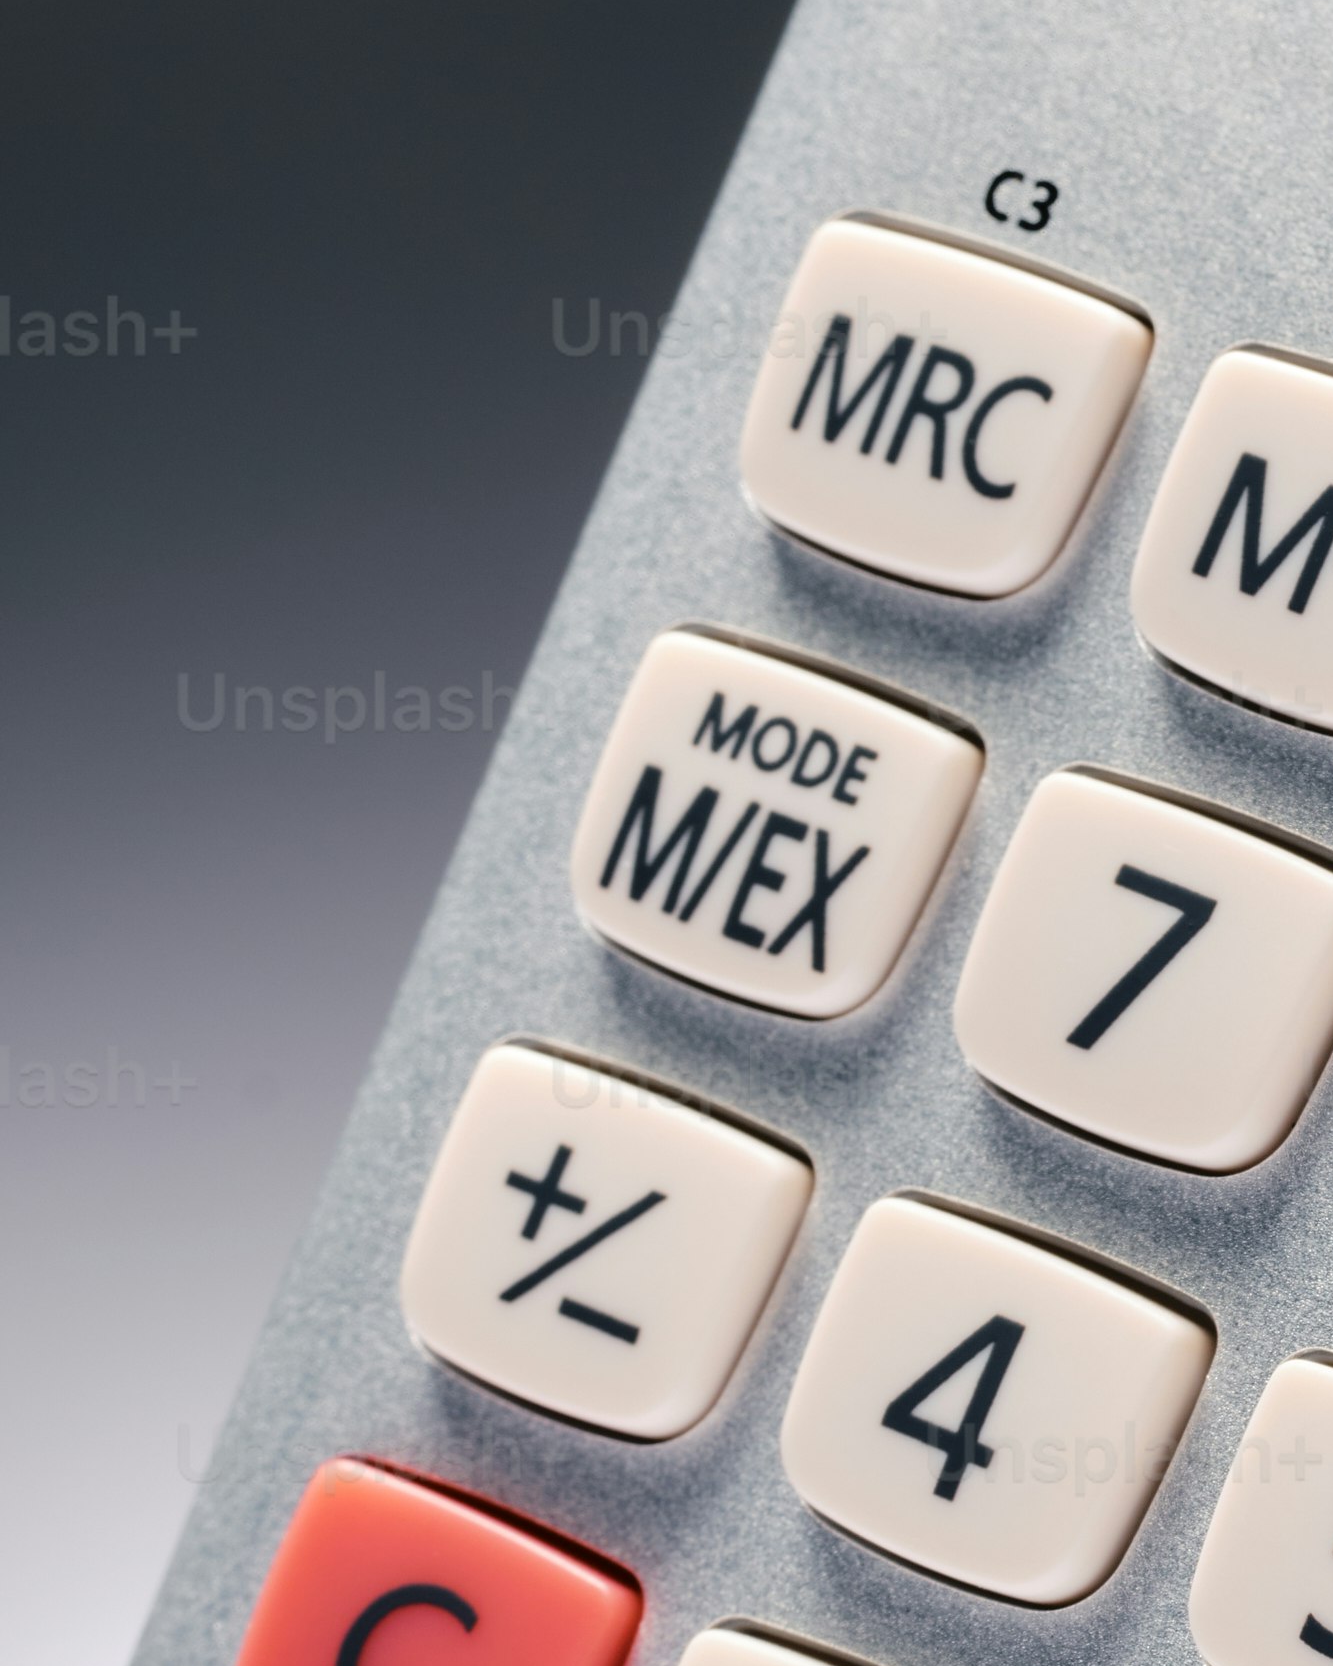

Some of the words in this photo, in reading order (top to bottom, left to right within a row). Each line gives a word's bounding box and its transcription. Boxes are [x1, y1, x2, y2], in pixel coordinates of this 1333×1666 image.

[985, 170, 1059, 232] C3
[791, 315, 1053, 500] MRC
[692, 690, 879, 809] MODE
[600, 762, 871, 976] M/EX
[1066, 865, 1217, 1050] 7
[882, 1316, 1025, 1501] 4
